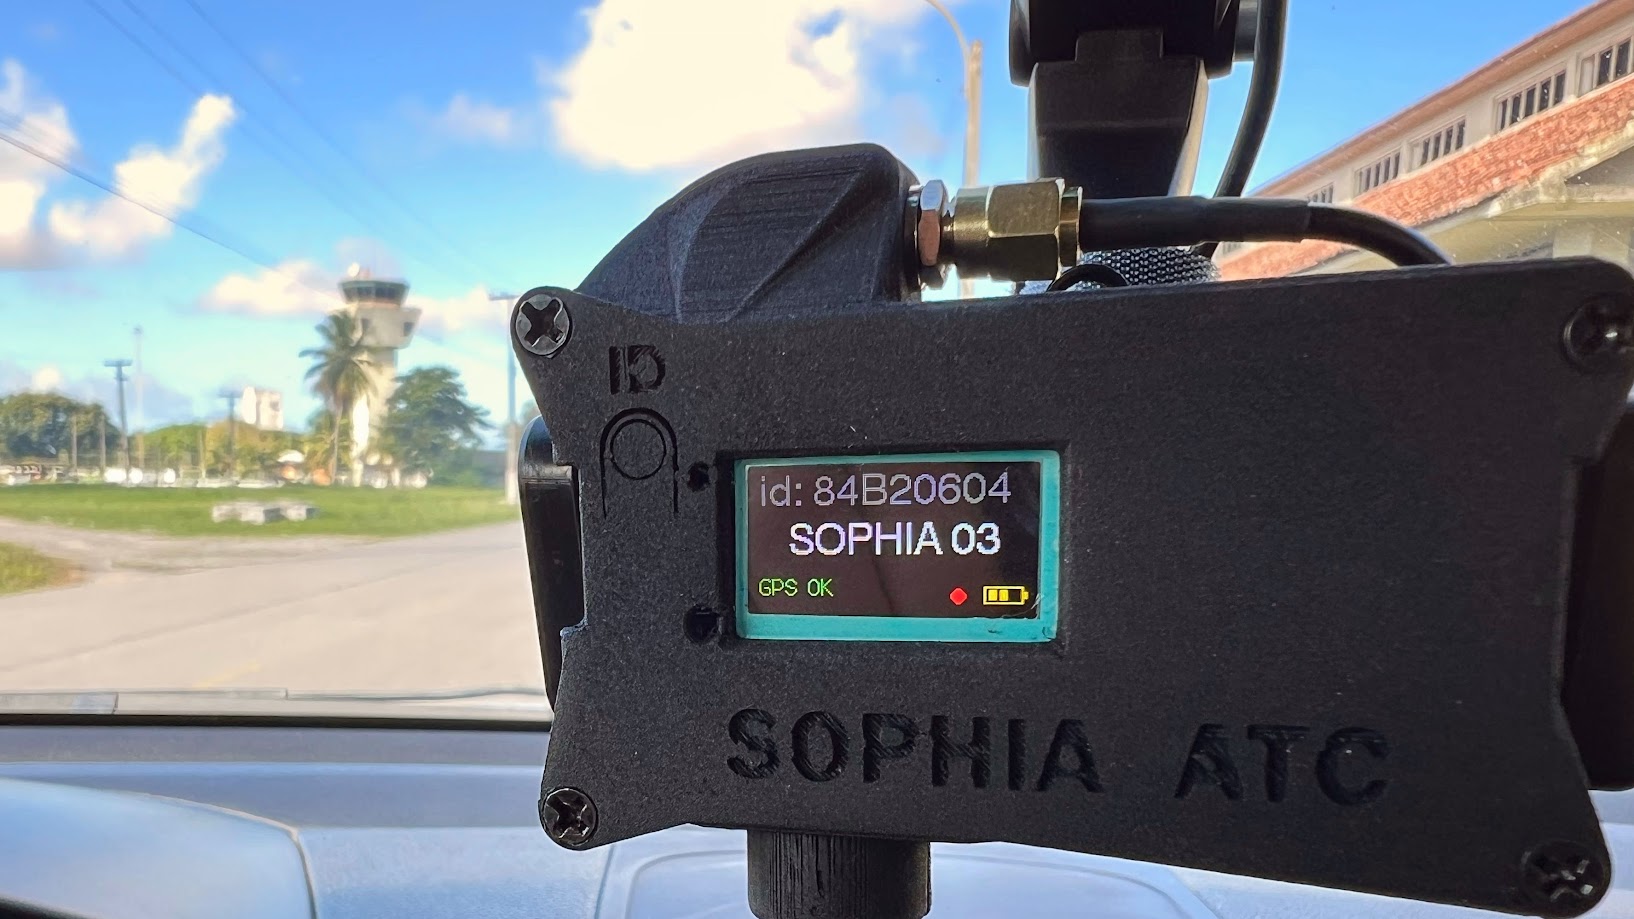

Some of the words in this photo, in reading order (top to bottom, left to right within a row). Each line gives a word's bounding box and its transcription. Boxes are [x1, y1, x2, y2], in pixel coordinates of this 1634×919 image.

[609, 344, 666, 394] ID
[761, 475, 802, 507] id:
[813, 471, 1012, 506] 84B20604
[789, 521, 943, 556] SOPHIA
[951, 522, 1001, 556] 03
[758, 578, 798, 598] GPS
[807, 578, 834, 598] OK
[727, 708, 1104, 793] SOPHIA
[1174, 723, 1389, 804] ATC
